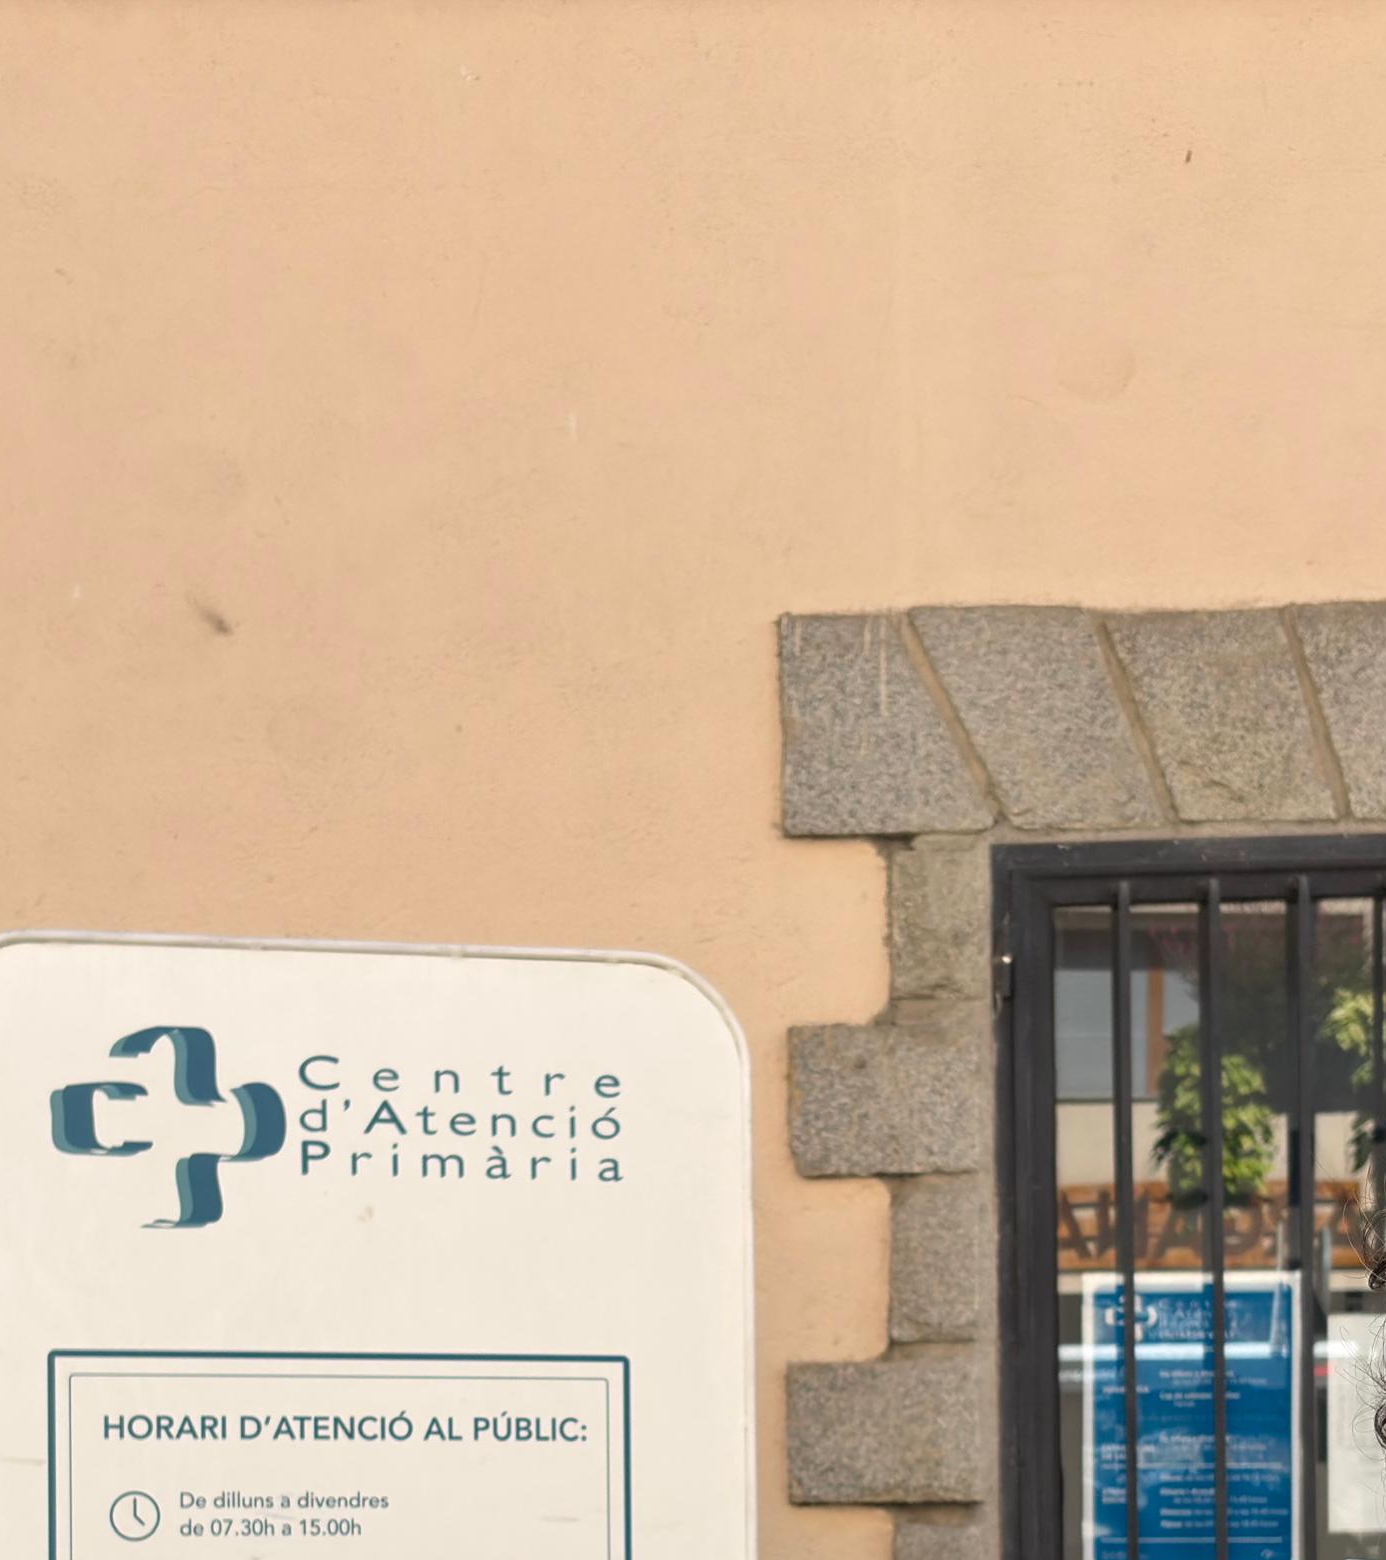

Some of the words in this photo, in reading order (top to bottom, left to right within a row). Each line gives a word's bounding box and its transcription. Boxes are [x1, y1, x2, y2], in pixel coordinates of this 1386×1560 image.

[298, 1055, 621, 1098] Centre
[298, 1099, 621, 1140] d'Atenció
[300, 1140, 624, 1182] Primària
[104, 1414, 227, 1440] HORARI
[240, 1410, 413, 1441] D'ATENCIÓ
[424, 1416, 464, 1441] AL
[474, 1410, 587, 1442] PÚBLIC:
[180, 1491, 207, 1509] De
[213, 1490, 275, 1509] dilluns
[281, 1495, 291, 1509] a
[297, 1490, 389, 1509] divendres
[180, 1517, 204, 1536] de
[210, 1518, 275, 1537] 07.30h
[281, 1523, 292, 1537] a
[299, 1518, 362, 1537] 15.00h
